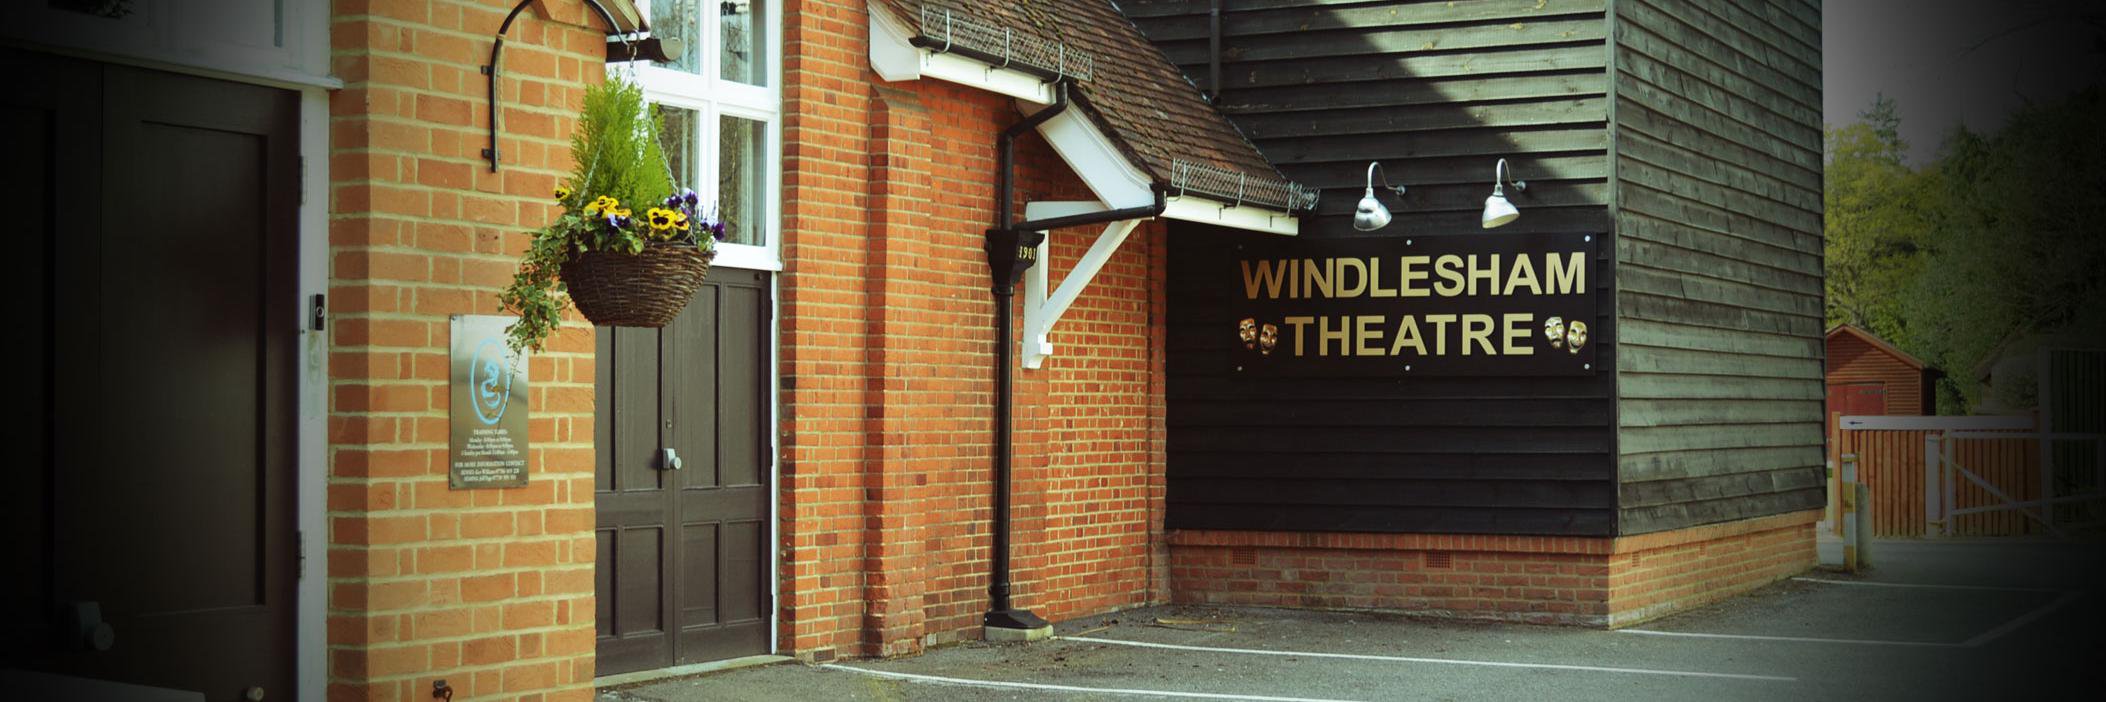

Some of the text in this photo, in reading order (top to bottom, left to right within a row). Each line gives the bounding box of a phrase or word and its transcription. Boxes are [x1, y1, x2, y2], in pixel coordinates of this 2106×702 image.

[1018, 245, 1036, 260] 1901
[1240, 252, 1586, 299] WINDLESHAM
[1284, 313, 1534, 356] THEATRE
